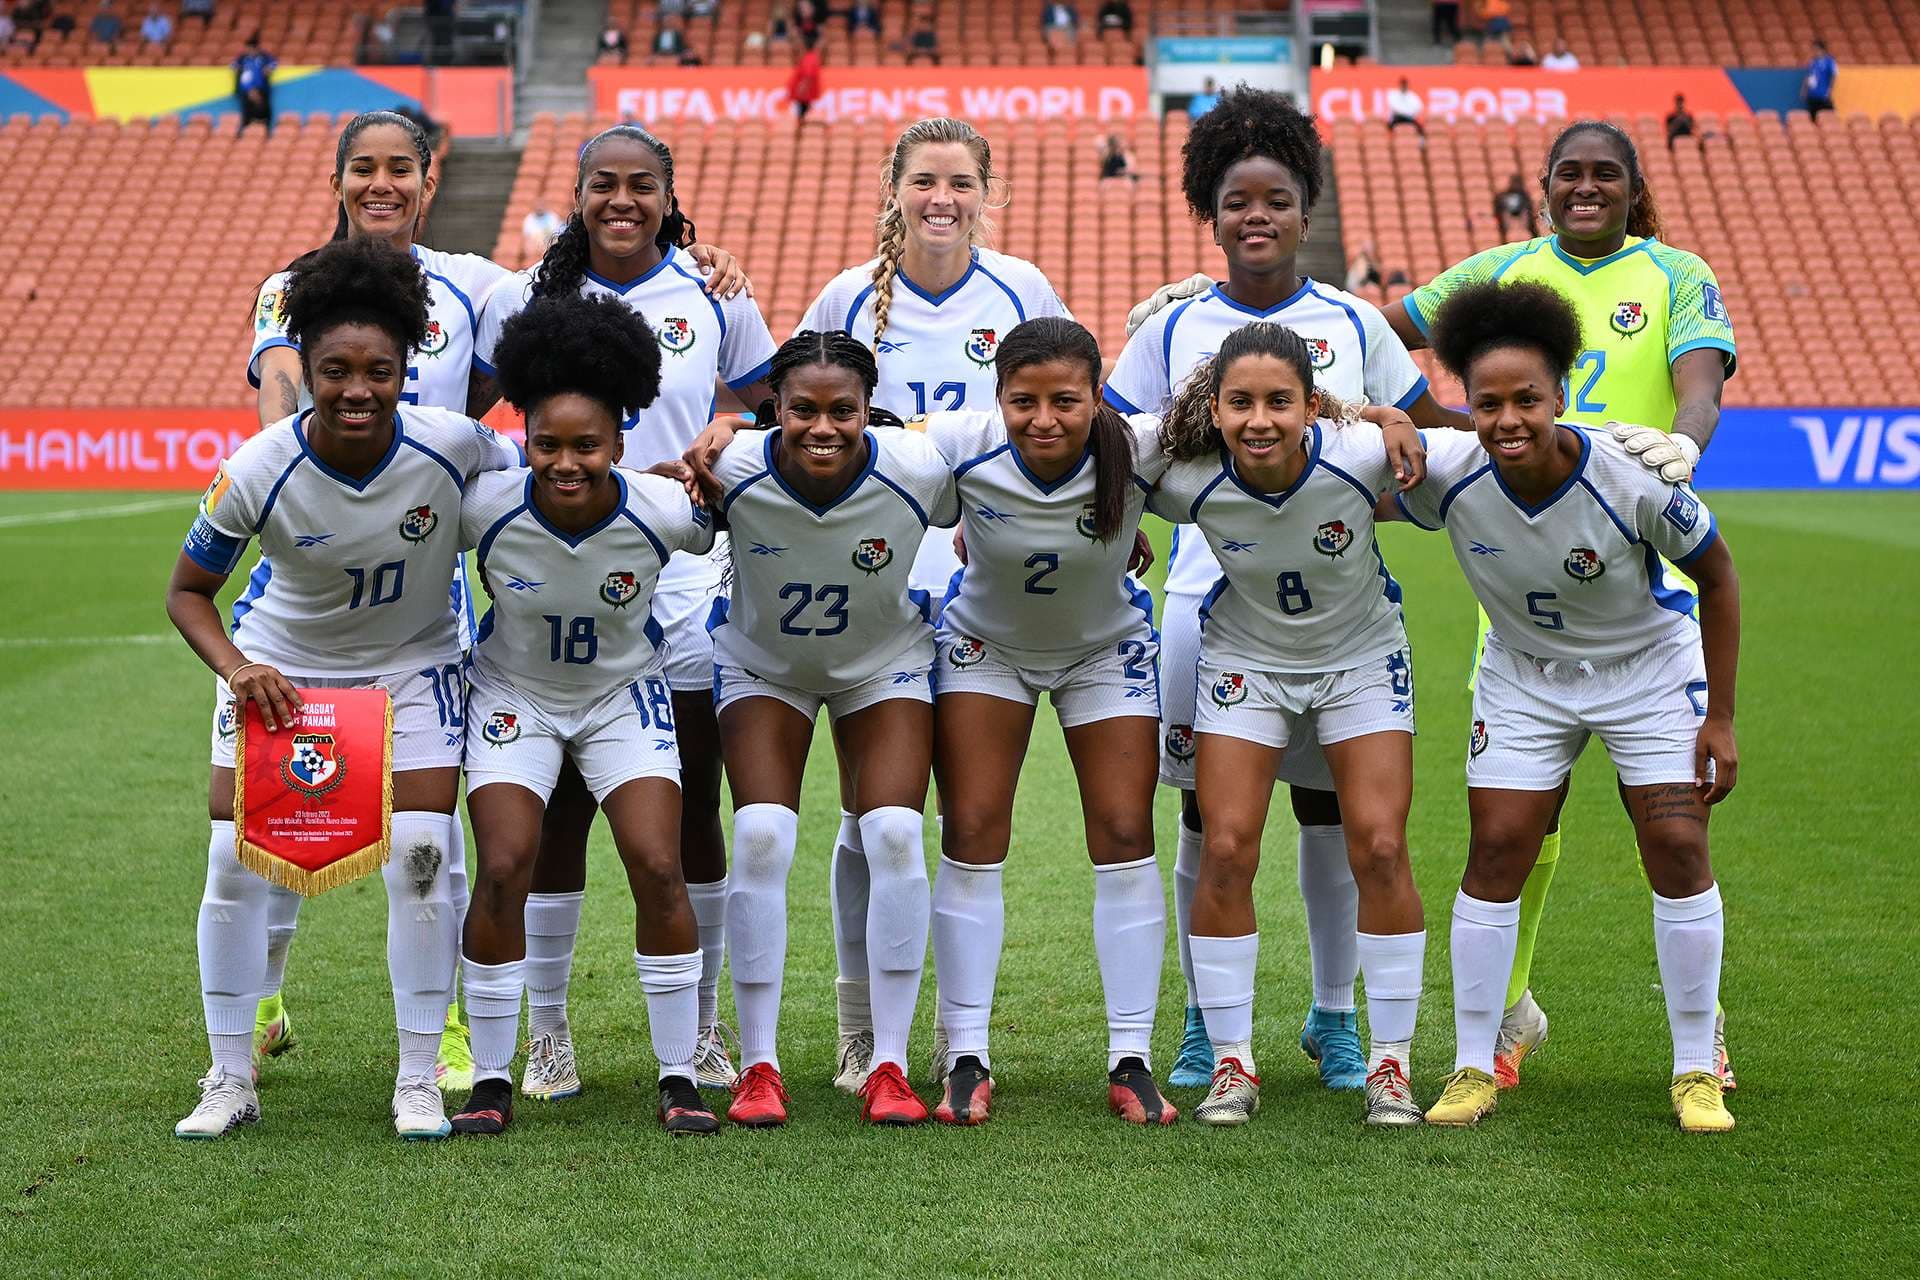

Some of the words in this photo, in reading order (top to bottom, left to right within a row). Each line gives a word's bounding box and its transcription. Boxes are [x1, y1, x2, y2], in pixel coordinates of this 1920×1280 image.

[617, 88, 714, 123] FIFA
[962, 87, 1134, 121] WORLD
[1319, 88, 1398, 122] CU
[344, 559, 405, 610] 10
[1024, 553, 1058, 595] 2
[1276, 571, 1313, 615] 8
[779, 583, 848, 636] 23
[1526, 592, 1564, 630] 5
[542, 615, 597, 664] 18
[1118, 640, 1147, 680] 2
[420, 664, 464, 728] 10
[626, 679, 674, 732] 18
